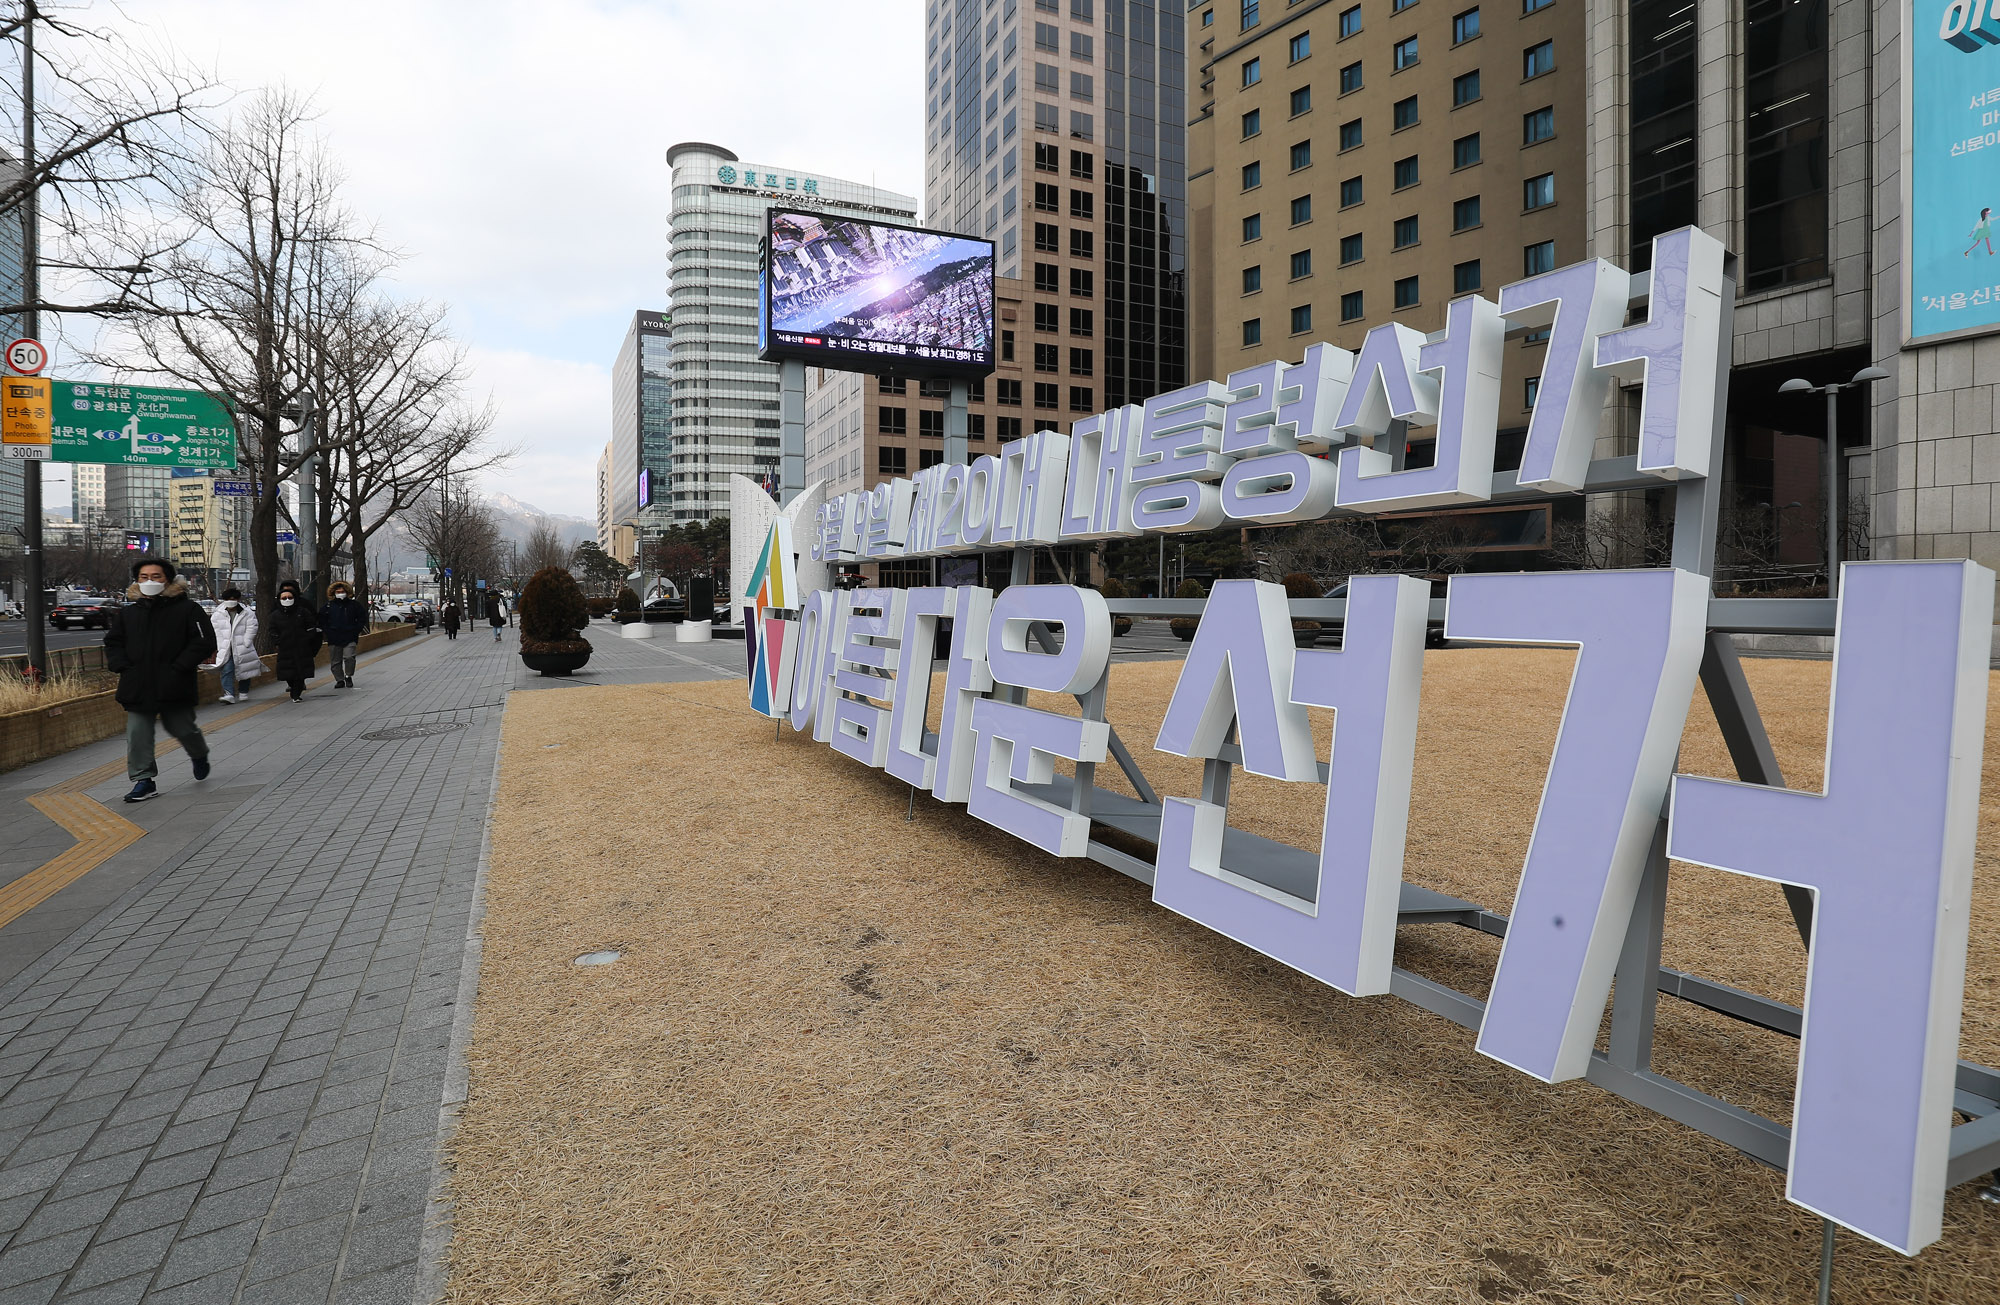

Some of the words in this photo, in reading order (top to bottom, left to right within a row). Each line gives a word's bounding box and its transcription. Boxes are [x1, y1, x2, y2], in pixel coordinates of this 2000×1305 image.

[743, 169, 820, 196] 東亞日報
[643, 320, 670, 329] KYOBO
[850, 339, 867, 351] 오는
[931, 349, 939, 358] 낮
[939, 348, 955, 360] 최고
[955, 350, 971, 362] 영하
[972, 352, 985, 362] 1도
[14, 348, 39, 365] 50
[93, 386, 132, 399] 독립문
[810, 492, 859, 561] 3월
[853, 476, 913, 558] 9일
[903, 430, 1069, 555] 제20대
[1060, 225, 1724, 534] 대통령선거
[76, 401, 87, 409] 50
[92, 401, 132, 413] 광화문
[137, 402, 169, 413] 光化門
[136, 410, 197, 420] Gwanghwamun
[15, 421, 38, 430] Photo
[5, 430, 48, 438] enforcement
[51, 425, 88, 438] 대문역
[108, 431, 115, 440] 6
[185, 425, 230, 438] 종로1가
[76, 438, 89, 446] Stn
[152, 434, 159, 442] 6
[186, 437, 208, 446] Jongno
[12, 447, 43, 458] 300m
[178, 446, 221, 458] 청계1가
[122, 455, 148, 463] 140m
[177, 456, 208, 466] Cheonggye
[790, 584, 1112, 858] 아름다운
[1153, 557, 1996, 1257] 선거
